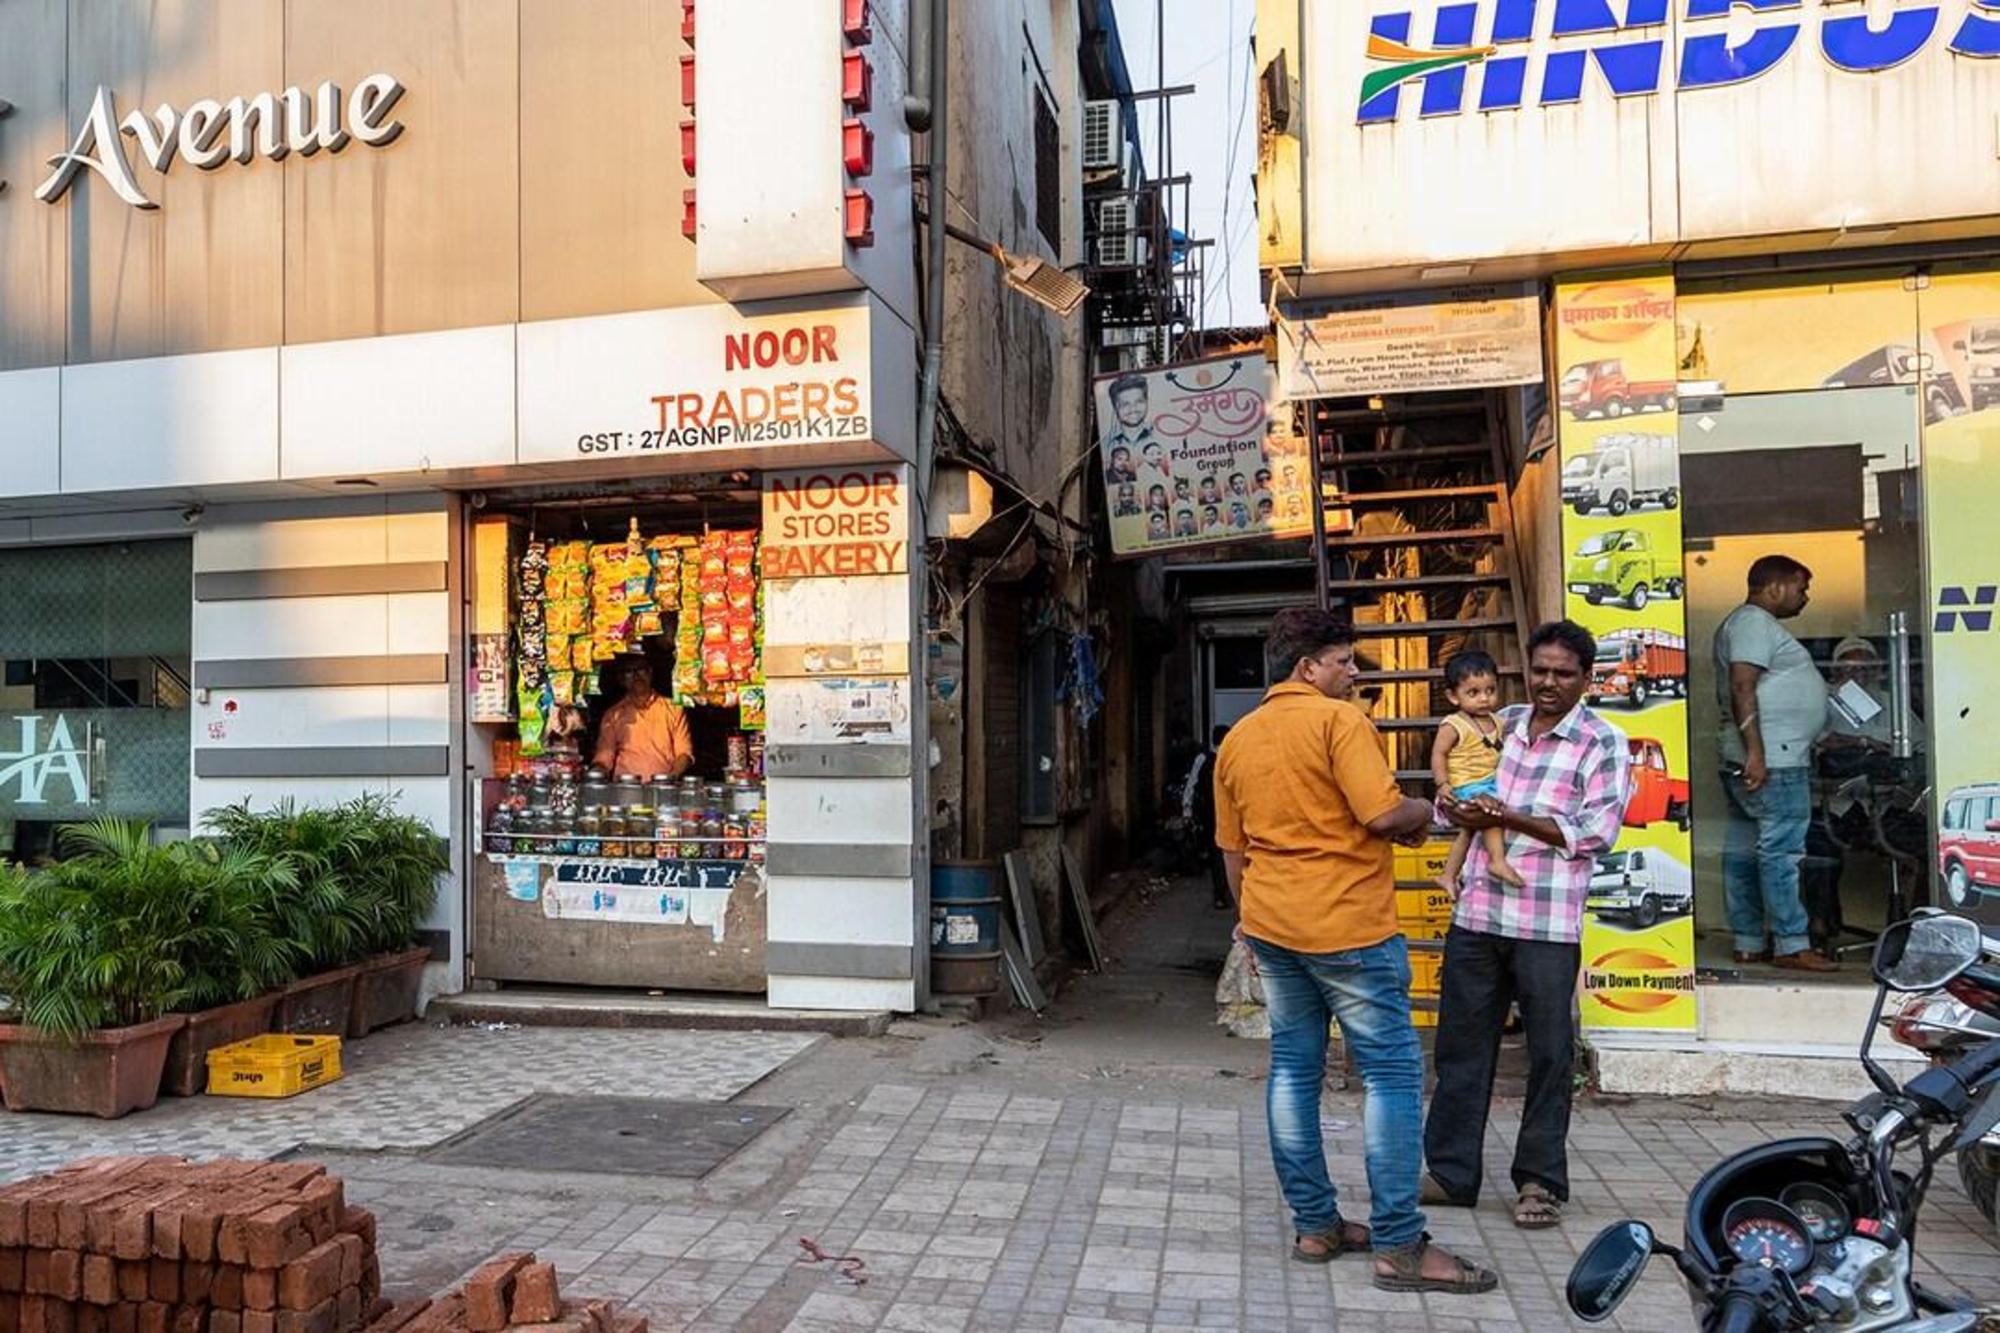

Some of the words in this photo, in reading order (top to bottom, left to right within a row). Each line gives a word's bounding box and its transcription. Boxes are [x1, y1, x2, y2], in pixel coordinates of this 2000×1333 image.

[1355, 0, 2000, 126] HINDU
[34, 73, 407, 210] Avenue
[725, 325, 838, 372] NOOR
[651, 378, 860, 431] TRADERS
[1169, 440, 1257, 460] Foundation
[1196, 457, 1236, 474] Group
[772, 471, 899, 512] NOOR
[782, 511, 890, 540] STORES
[761, 541, 901, 577] BAKERY
[1584, 970, 1606, 989] Low
[1608, 973, 1640, 988] Down
[1643, 972, 1696, 992] Payment
